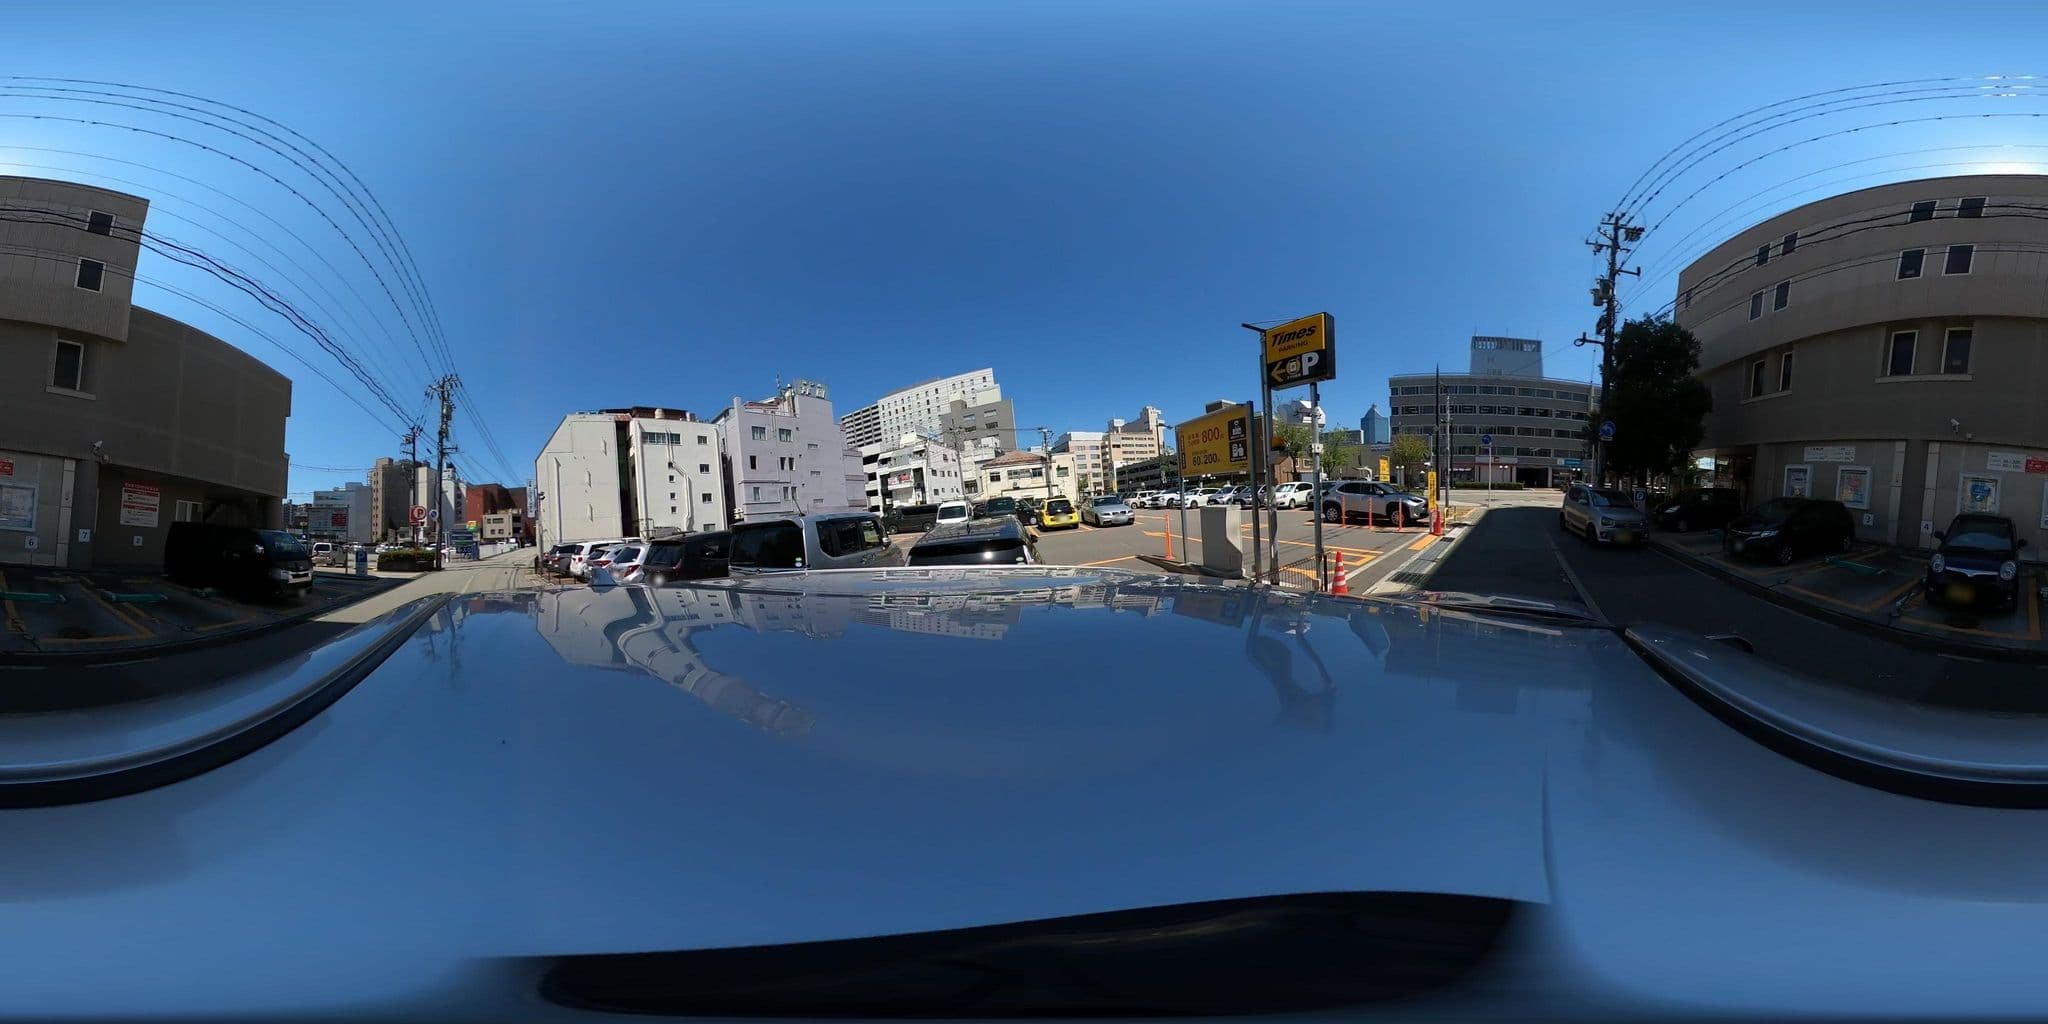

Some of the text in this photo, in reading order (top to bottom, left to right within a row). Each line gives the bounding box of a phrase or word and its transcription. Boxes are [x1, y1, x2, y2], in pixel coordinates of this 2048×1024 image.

[1271, 326, 1317, 348] Times
[1302, 352, 1319, 376] P
[417, 508, 424, 517] P
[1923, 523, 1929, 531] 4
[28, 538, 34, 547] 6
